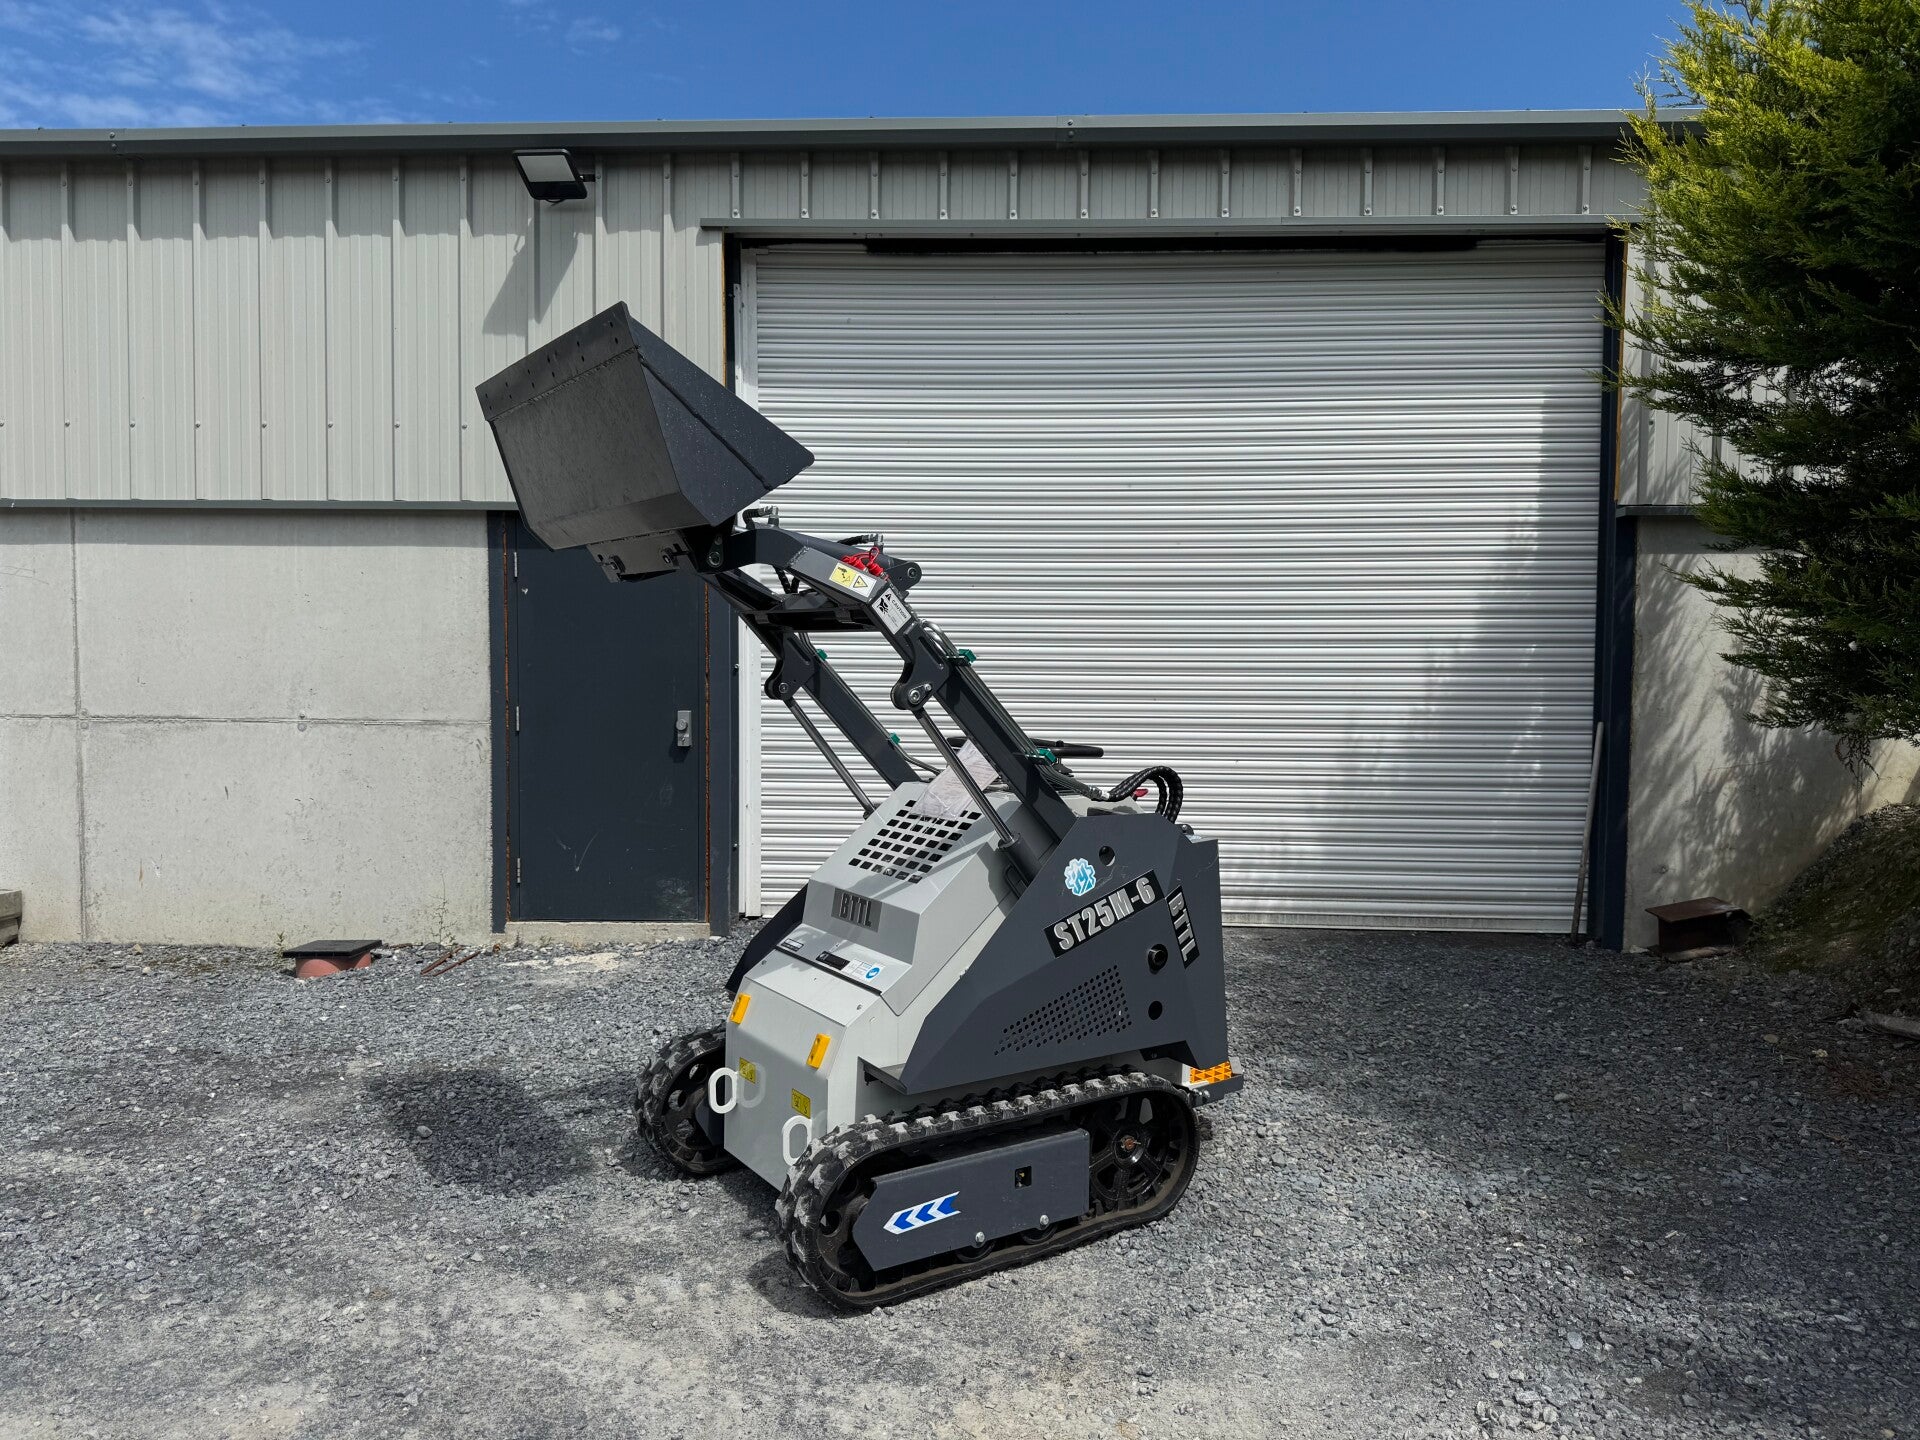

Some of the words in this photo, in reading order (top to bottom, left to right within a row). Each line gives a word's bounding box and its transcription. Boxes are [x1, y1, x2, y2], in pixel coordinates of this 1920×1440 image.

[891, 599, 907, 619] CAUTION
[838, 891, 872, 927] BTTL
[1053, 876, 1156, 950] ST25M-6
[1168, 891, 1197, 962] BTTL
